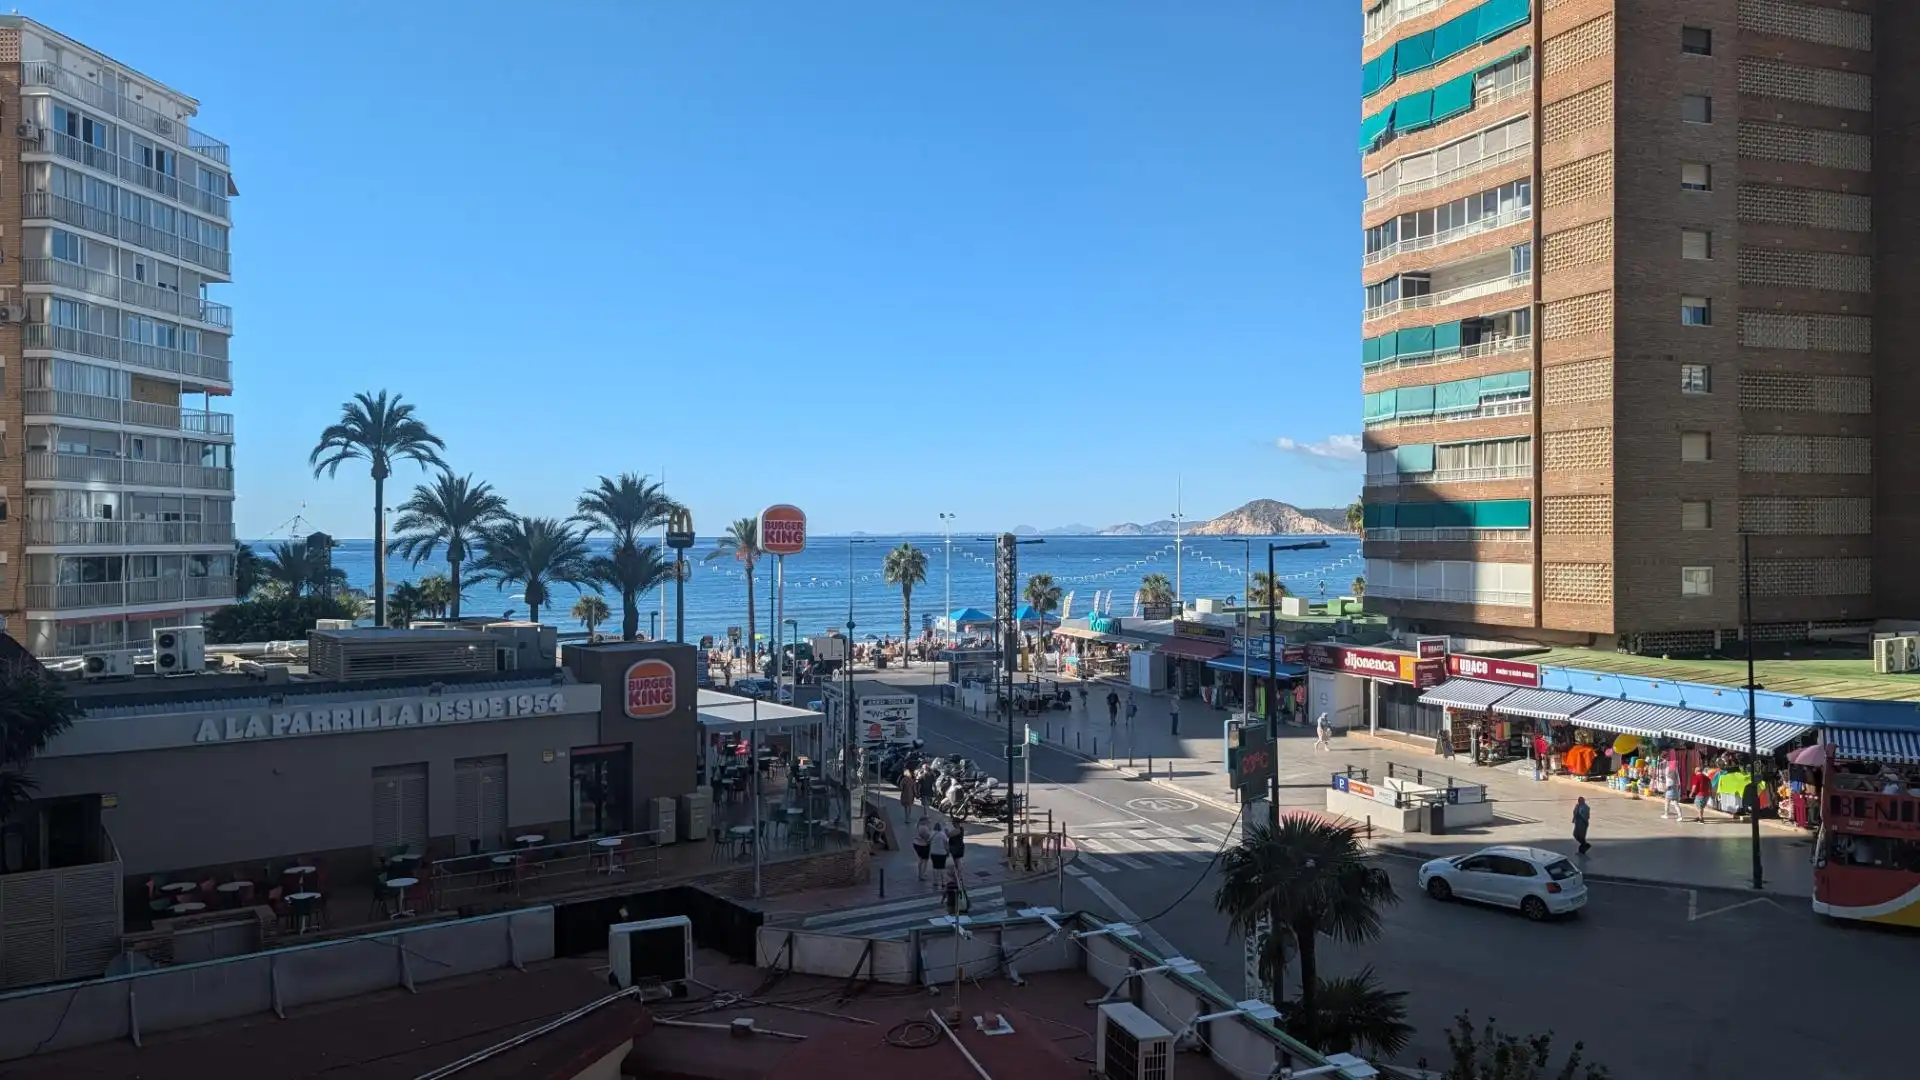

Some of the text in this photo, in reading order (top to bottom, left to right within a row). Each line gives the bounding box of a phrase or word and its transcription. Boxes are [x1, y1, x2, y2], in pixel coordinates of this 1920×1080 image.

[764, 520, 803, 532] BURGER
[764, 530, 803, 545] KING
[1344, 651, 1396, 673] Jijonenca
[1459, 658, 1488, 675] UDACO
[628, 676, 673, 691] BURGER
[628, 688, 673, 706] KING
[195, 691, 567, 742] A LA PARRILLA DESDE 1954
[1339, 778, 1345, 788] P
[1830, 795, 1920, 823] BENI
